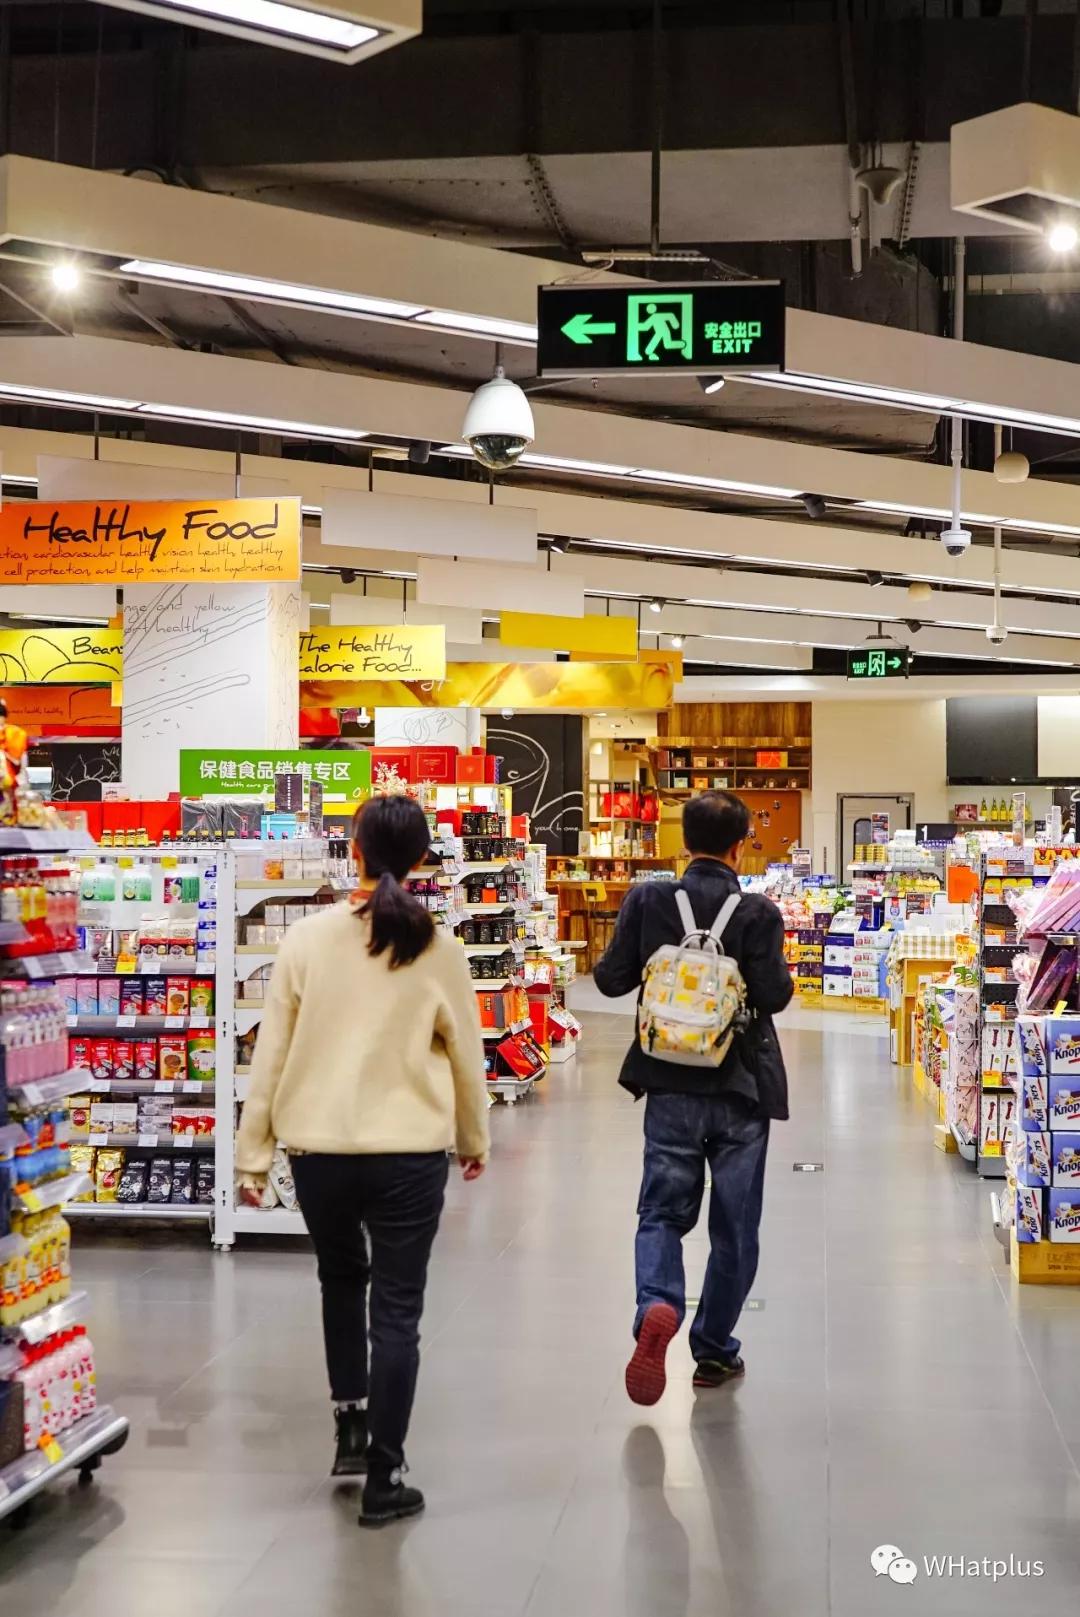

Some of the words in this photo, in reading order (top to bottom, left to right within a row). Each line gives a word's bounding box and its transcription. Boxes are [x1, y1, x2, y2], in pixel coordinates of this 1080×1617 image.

[704, 321, 761, 339] 安全出口
[712, 339, 753, 354] EXIT
[24, 504, 167, 561] Healthy
[182, 503, 278, 540] Food
[0, 546, 28, 561] tion,
[4, 562, 22, 576] cell
[95, 560, 117, 575] and
[121, 560, 144, 580] help
[194, 592, 236, 620] yellow
[156, 615, 209, 643] healthy
[299, 633, 331, 653] The
[338, 633, 412, 662] Healthy
[200, 760, 352, 781] 保健食品销售专区
[921, 825, 928, 841] 1
[1054, 1102, 1080, 1116] Knop
